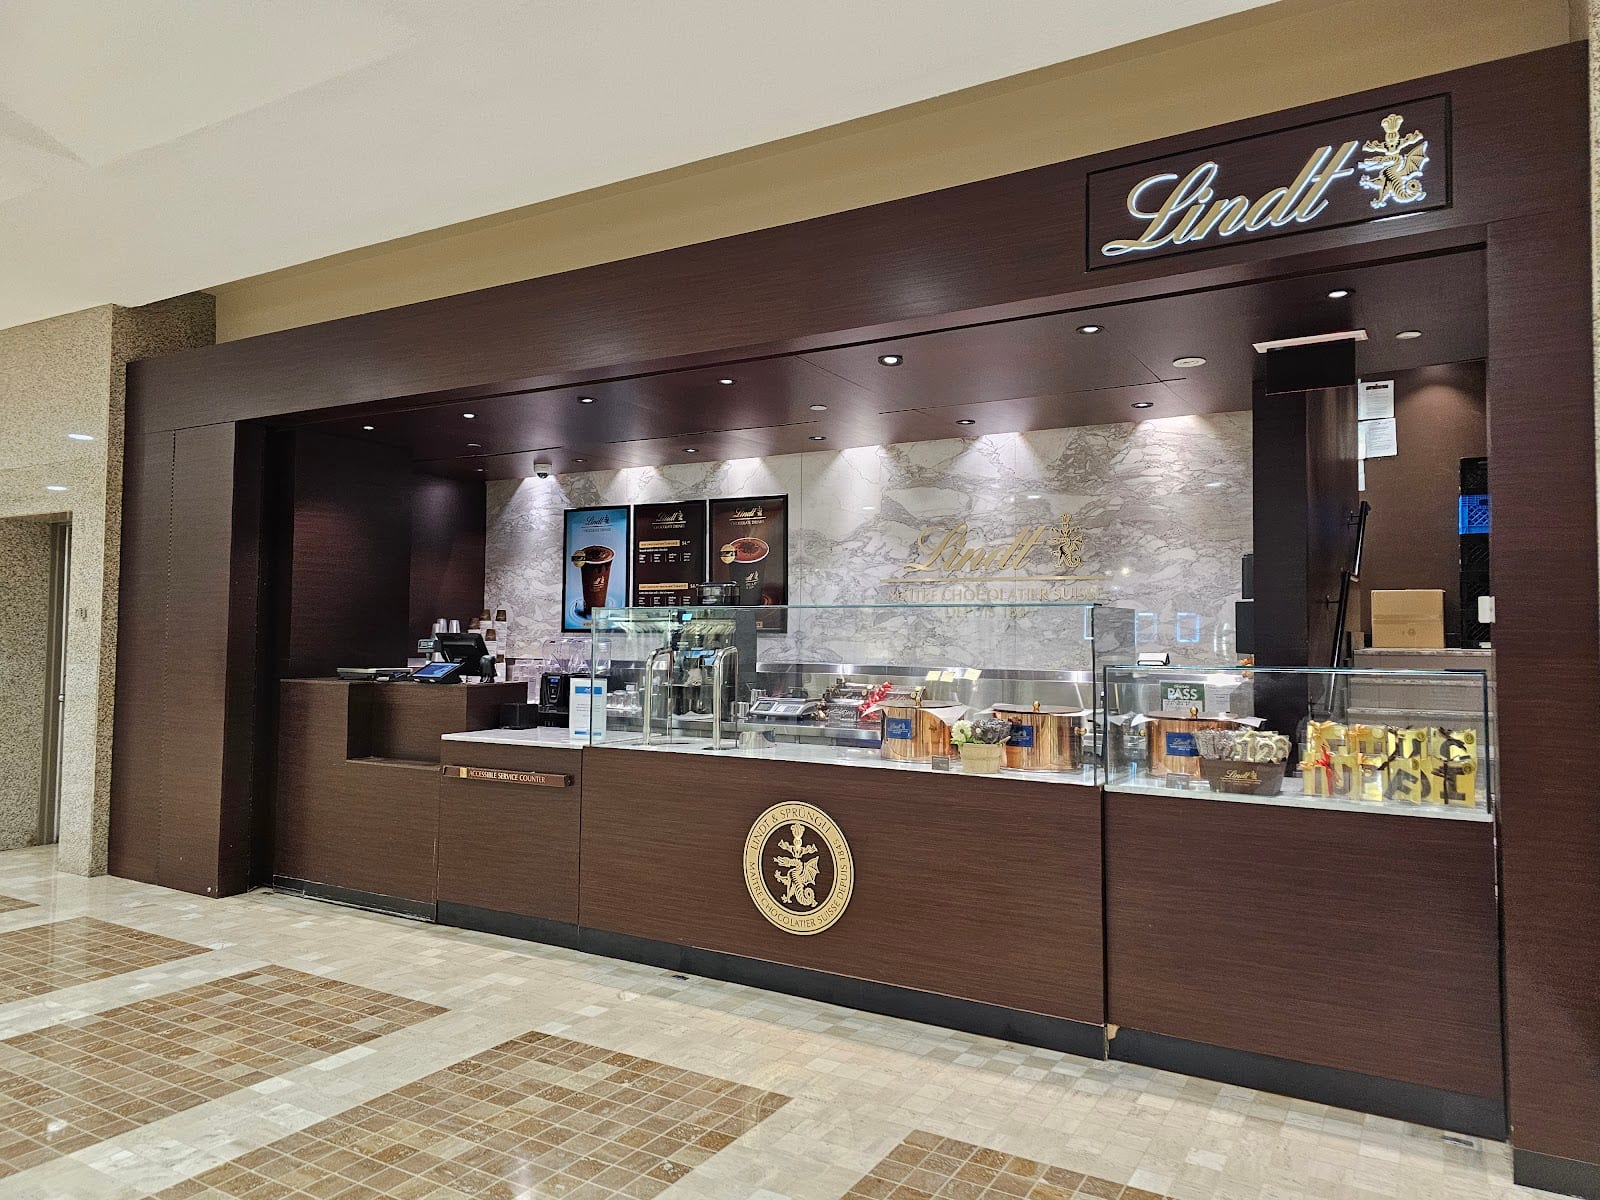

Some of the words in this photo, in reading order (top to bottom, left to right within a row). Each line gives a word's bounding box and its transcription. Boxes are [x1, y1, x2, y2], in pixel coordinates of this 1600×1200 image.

[1101, 140, 1359, 256] Lindt
[904, 521, 1046, 571] Lindt
[942, 586, 1048, 602] CHOCOLATIER
[1167, 688, 1198, 701] PASS
[469, 770, 497, 779] ACCESSIBLE
[497, 772, 519, 781] SERVICE
[519, 774, 546, 783] COUNTER
[751, 819, 770, 850] LINDT
[780, 807, 831, 833] SPRÜNGLI
[833, 838, 846, 862] 1845
[837, 864, 848, 900] DEPUIS
[761, 899, 816, 927] CHOCOLATIER
[818, 902, 841, 922] SUISSE
